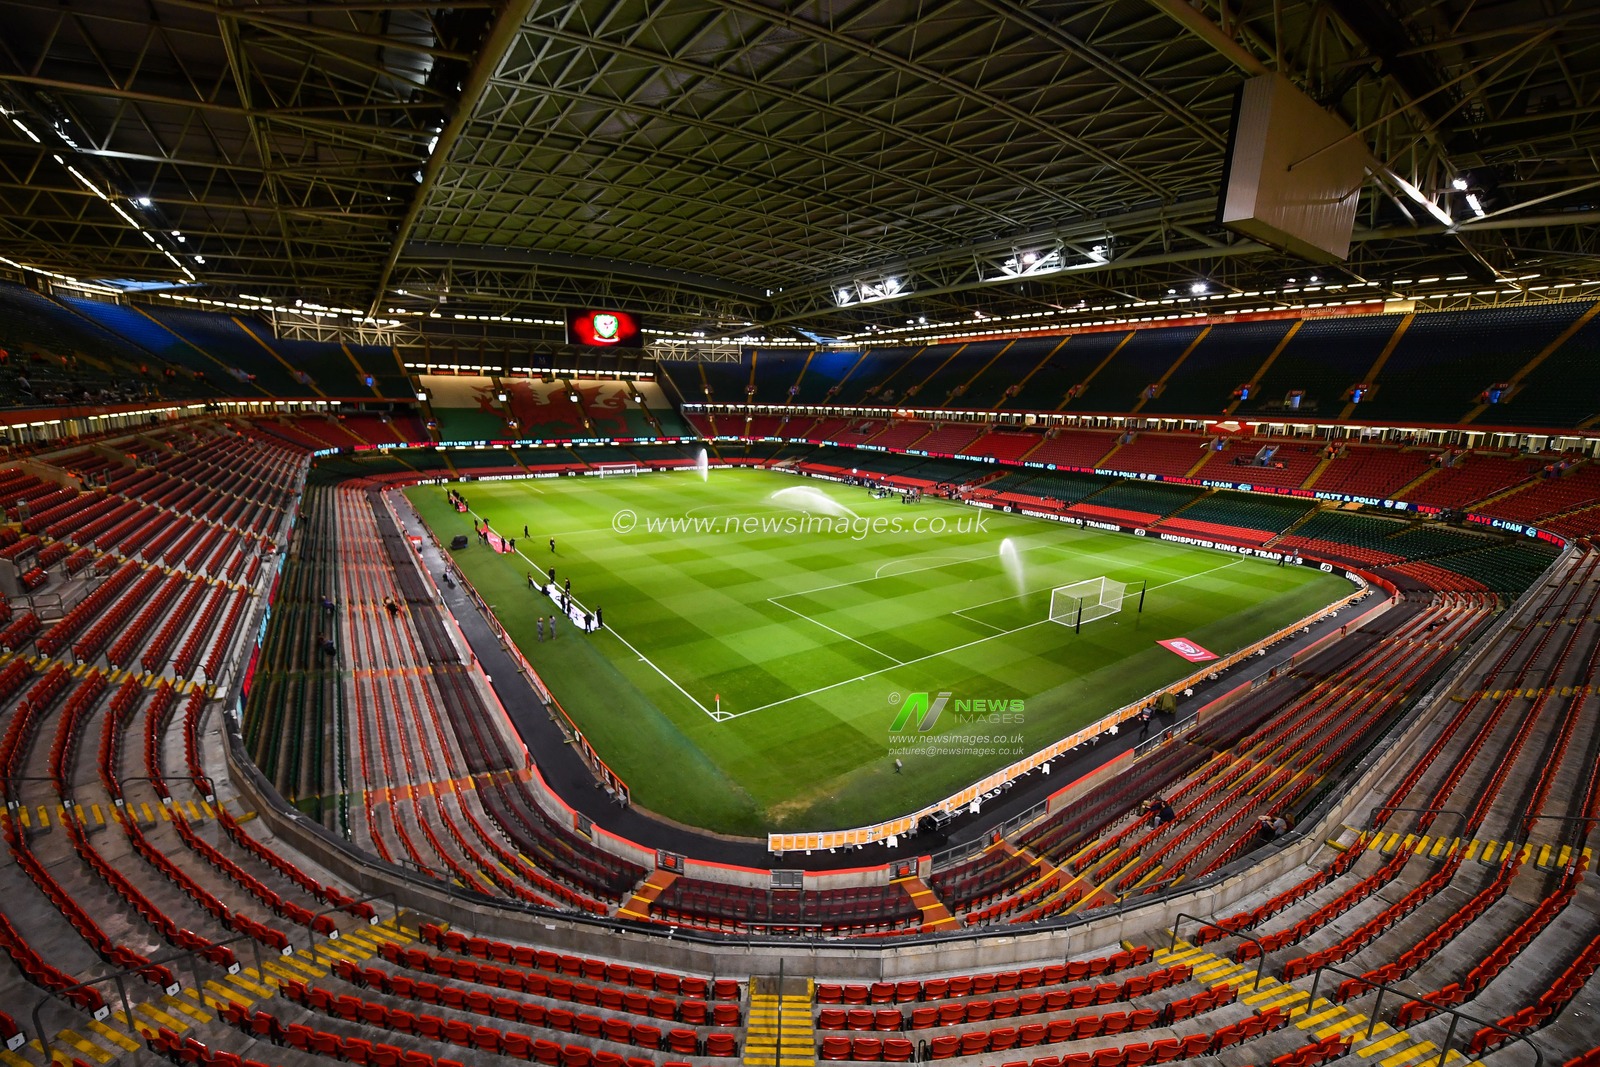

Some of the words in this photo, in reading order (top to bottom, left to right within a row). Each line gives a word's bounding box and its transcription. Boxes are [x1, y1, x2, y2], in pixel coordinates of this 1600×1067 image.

[1163, 476, 1200, 484] WEEKDAYS
[1202, 480, 1232, 488] 6-10AM
[1292, 489, 1314, 497] WITH
[1316, 492, 1342, 500] MATT
[1353, 496, 1380, 505] POLLY
[970, 501, 993, 509] TRAINERS
[1022, 510, 1058, 520] UNDISPUTED
[1060, 516, 1074, 524] KING
[1087, 520, 1120, 531] TRAINERS
[1492, 520, 1522, 532] 6-10AM
[1161, 533, 1213, 548] UNDISPUTED
[1215, 543, 1239, 553] KING
